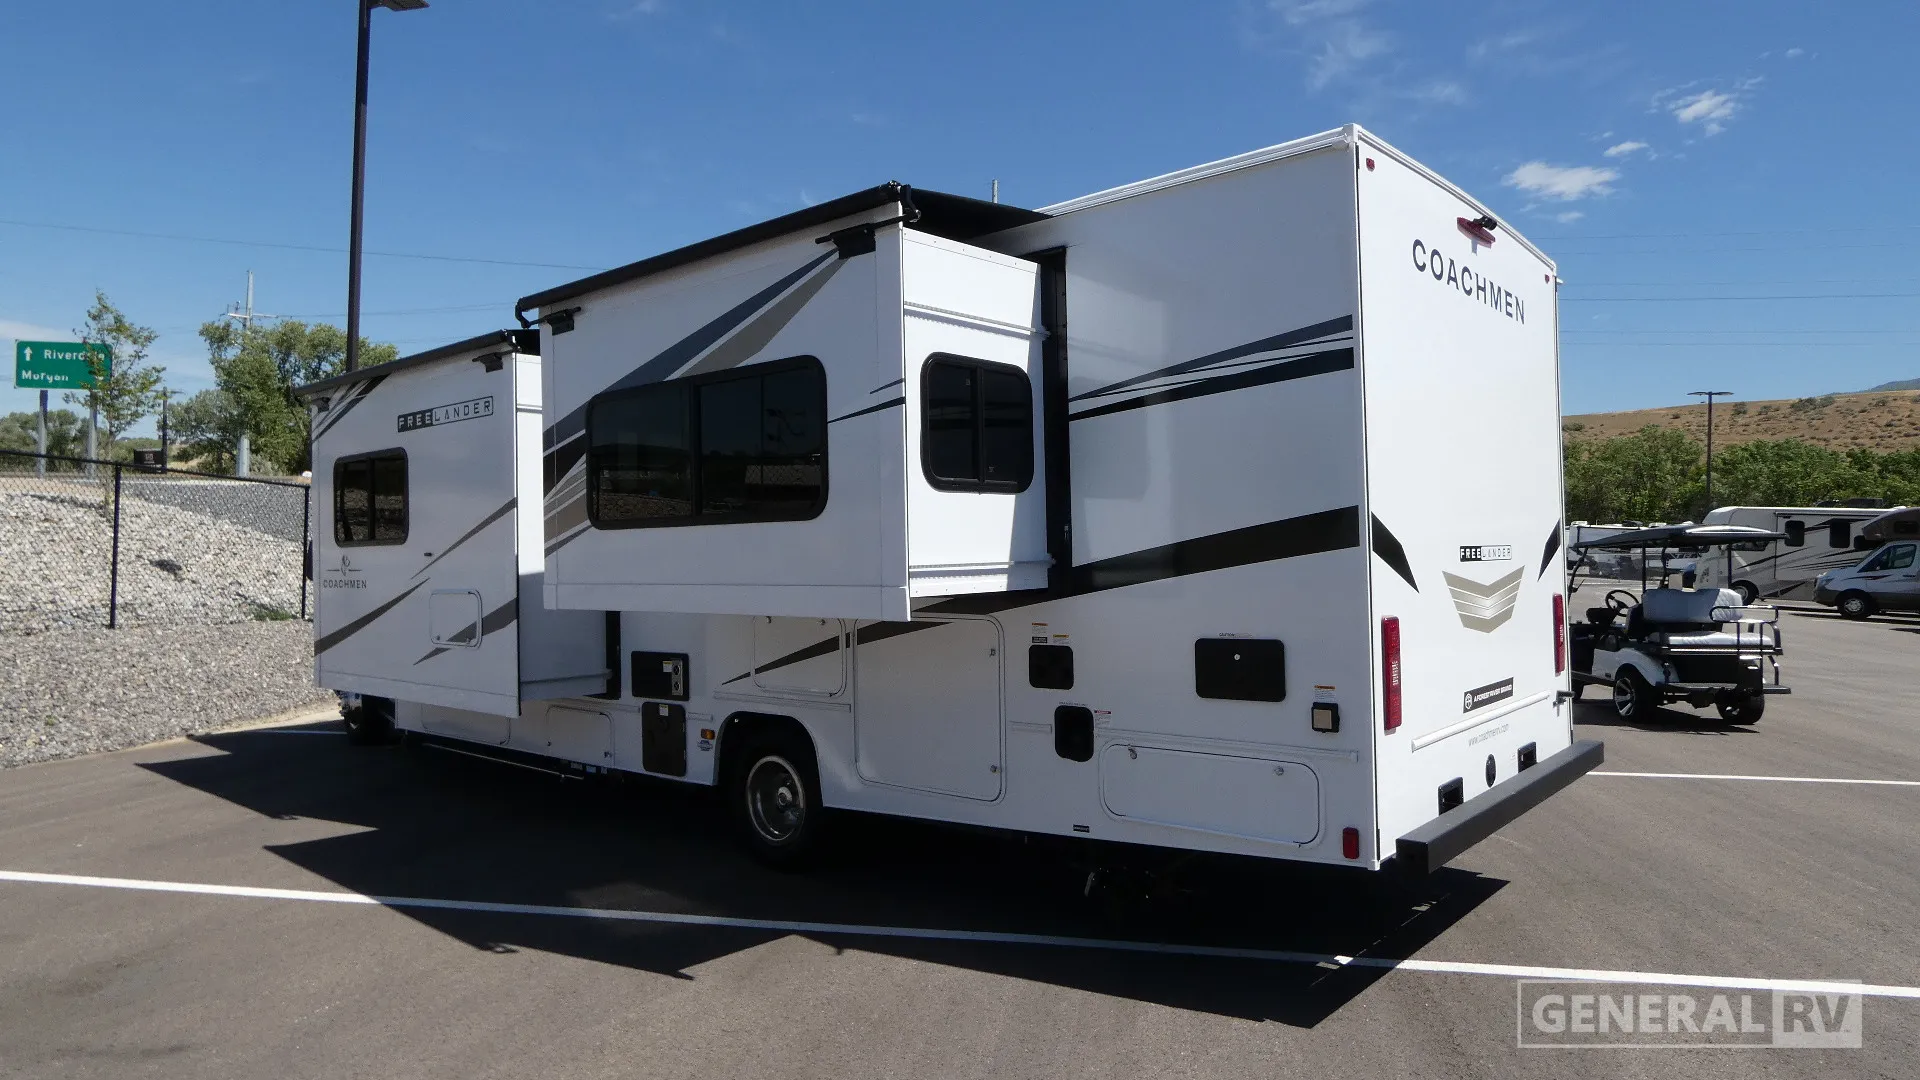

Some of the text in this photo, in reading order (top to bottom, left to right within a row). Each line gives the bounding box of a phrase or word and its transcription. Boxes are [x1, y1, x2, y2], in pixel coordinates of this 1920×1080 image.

[1412, 239, 1525, 325] COACHMEN
[44, 349, 105, 361] Riverde
[398, 400, 492, 429] FREELANDER
[1460, 547, 1511, 559] FREELANDER
[323, 579, 367, 589] COACHMEN
